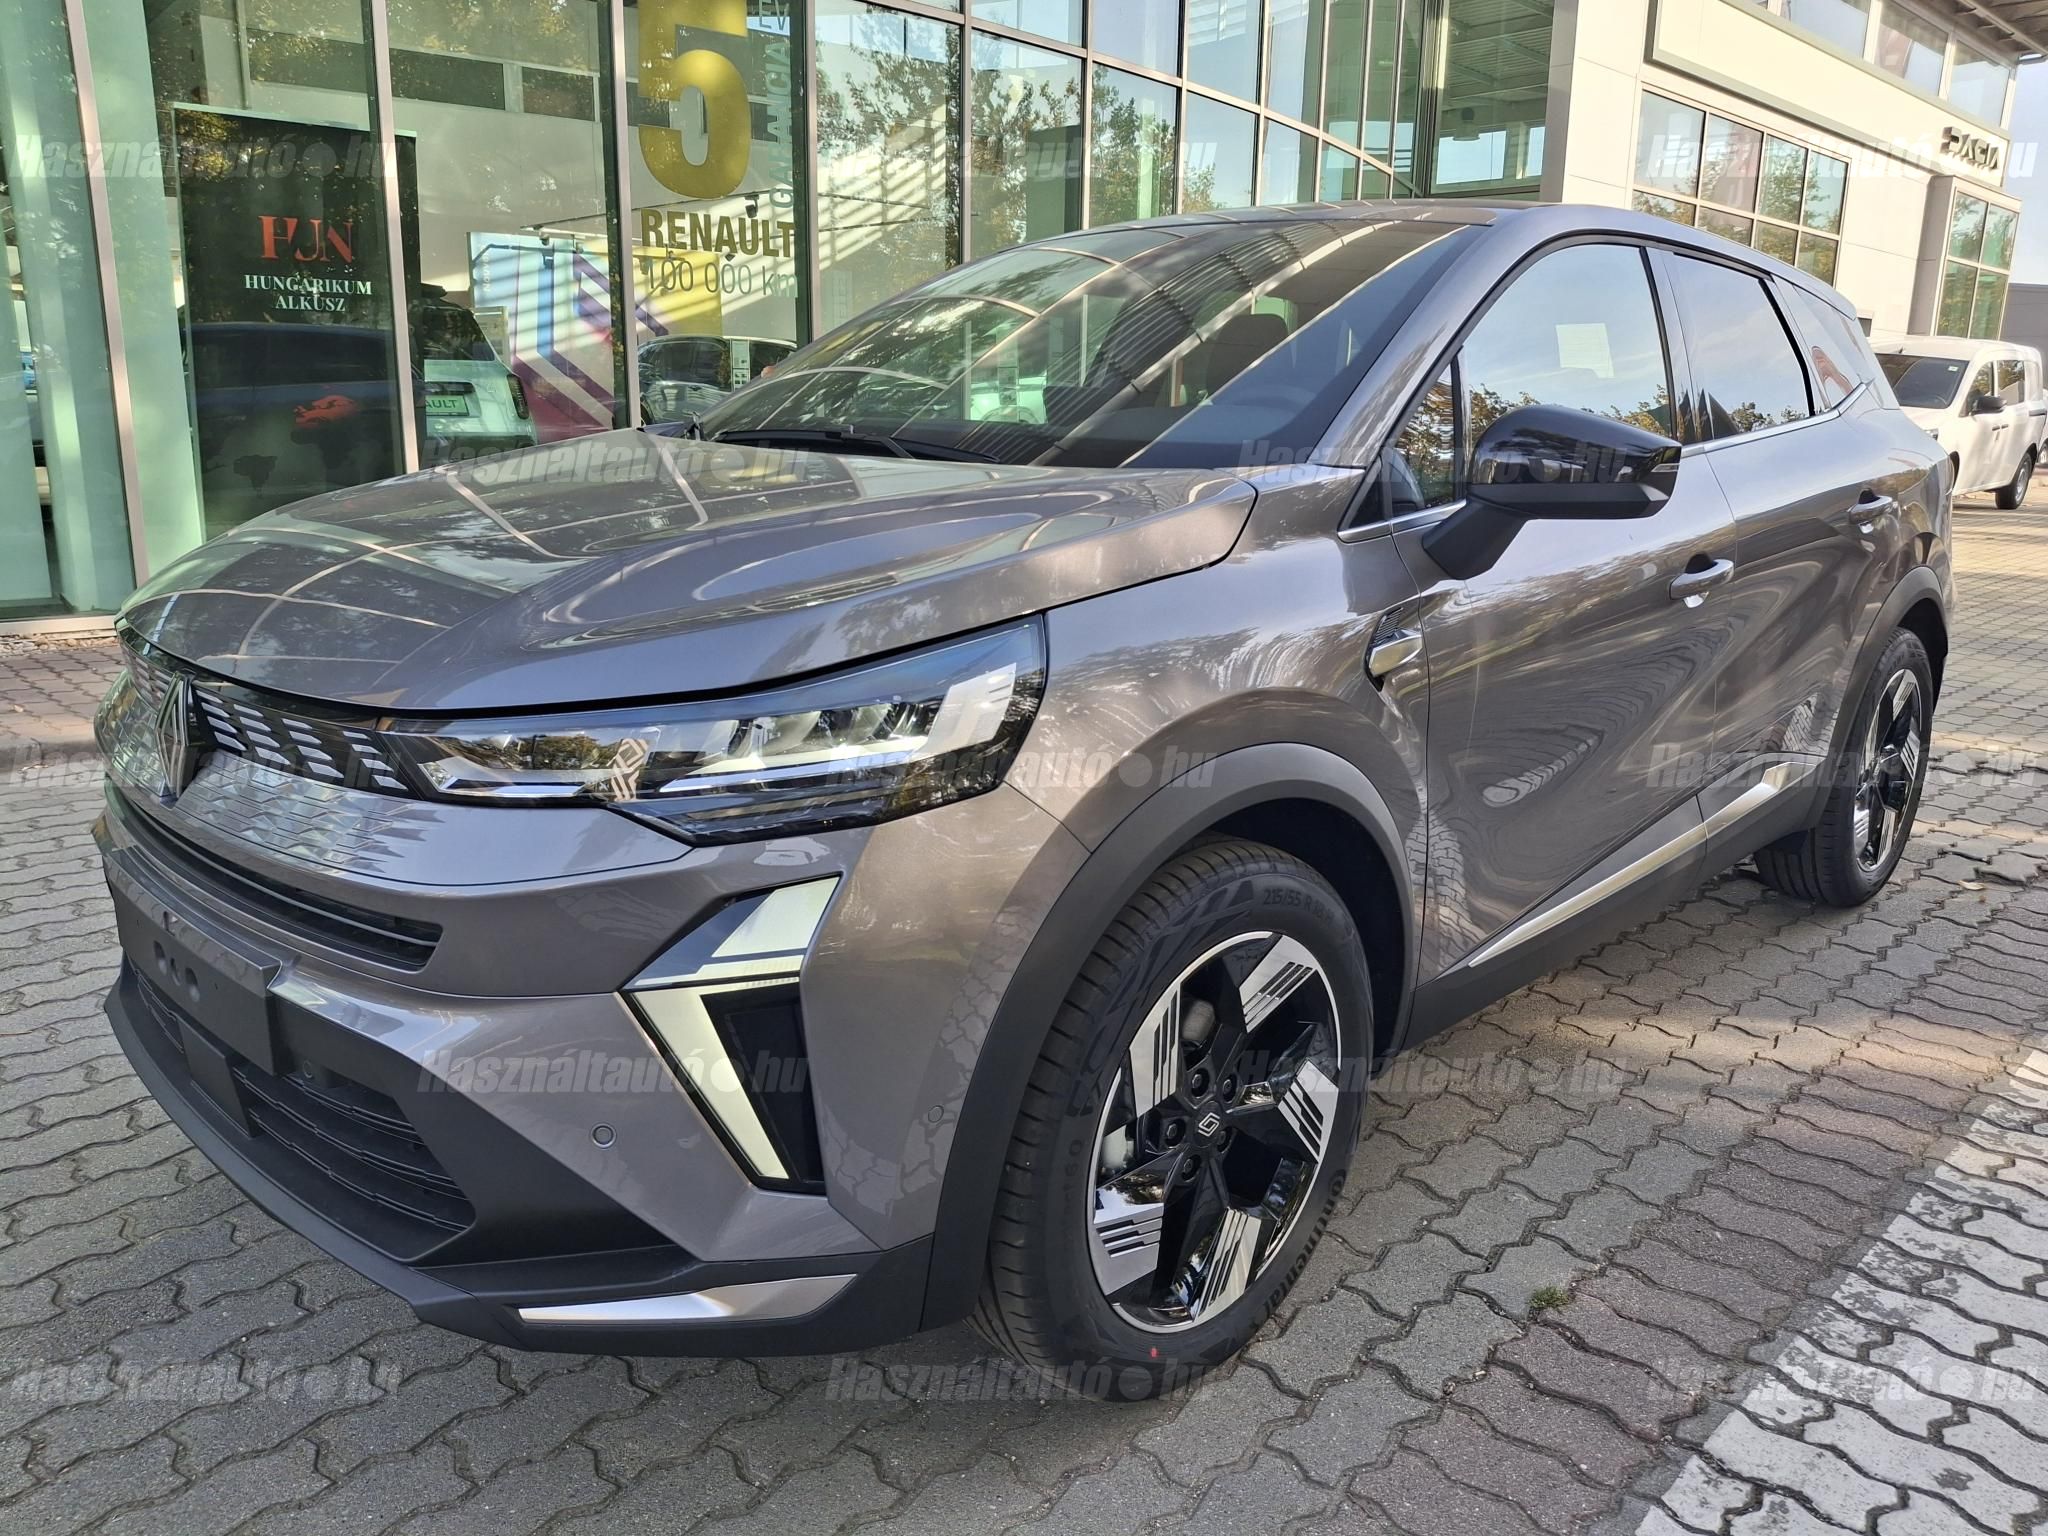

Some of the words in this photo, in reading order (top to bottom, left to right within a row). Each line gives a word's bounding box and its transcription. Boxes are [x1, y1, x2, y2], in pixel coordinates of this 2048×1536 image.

[638, 0, 750, 200] 5
[640, 208, 796, 258] RENAULT
[244, 274, 373, 295] HUNGARIKUM
[648, 259, 694, 292] 100
[704, 262, 752, 295] 000
[763, 265, 798, 298] km
[275, 295, 346, 312] ALKUSZ
